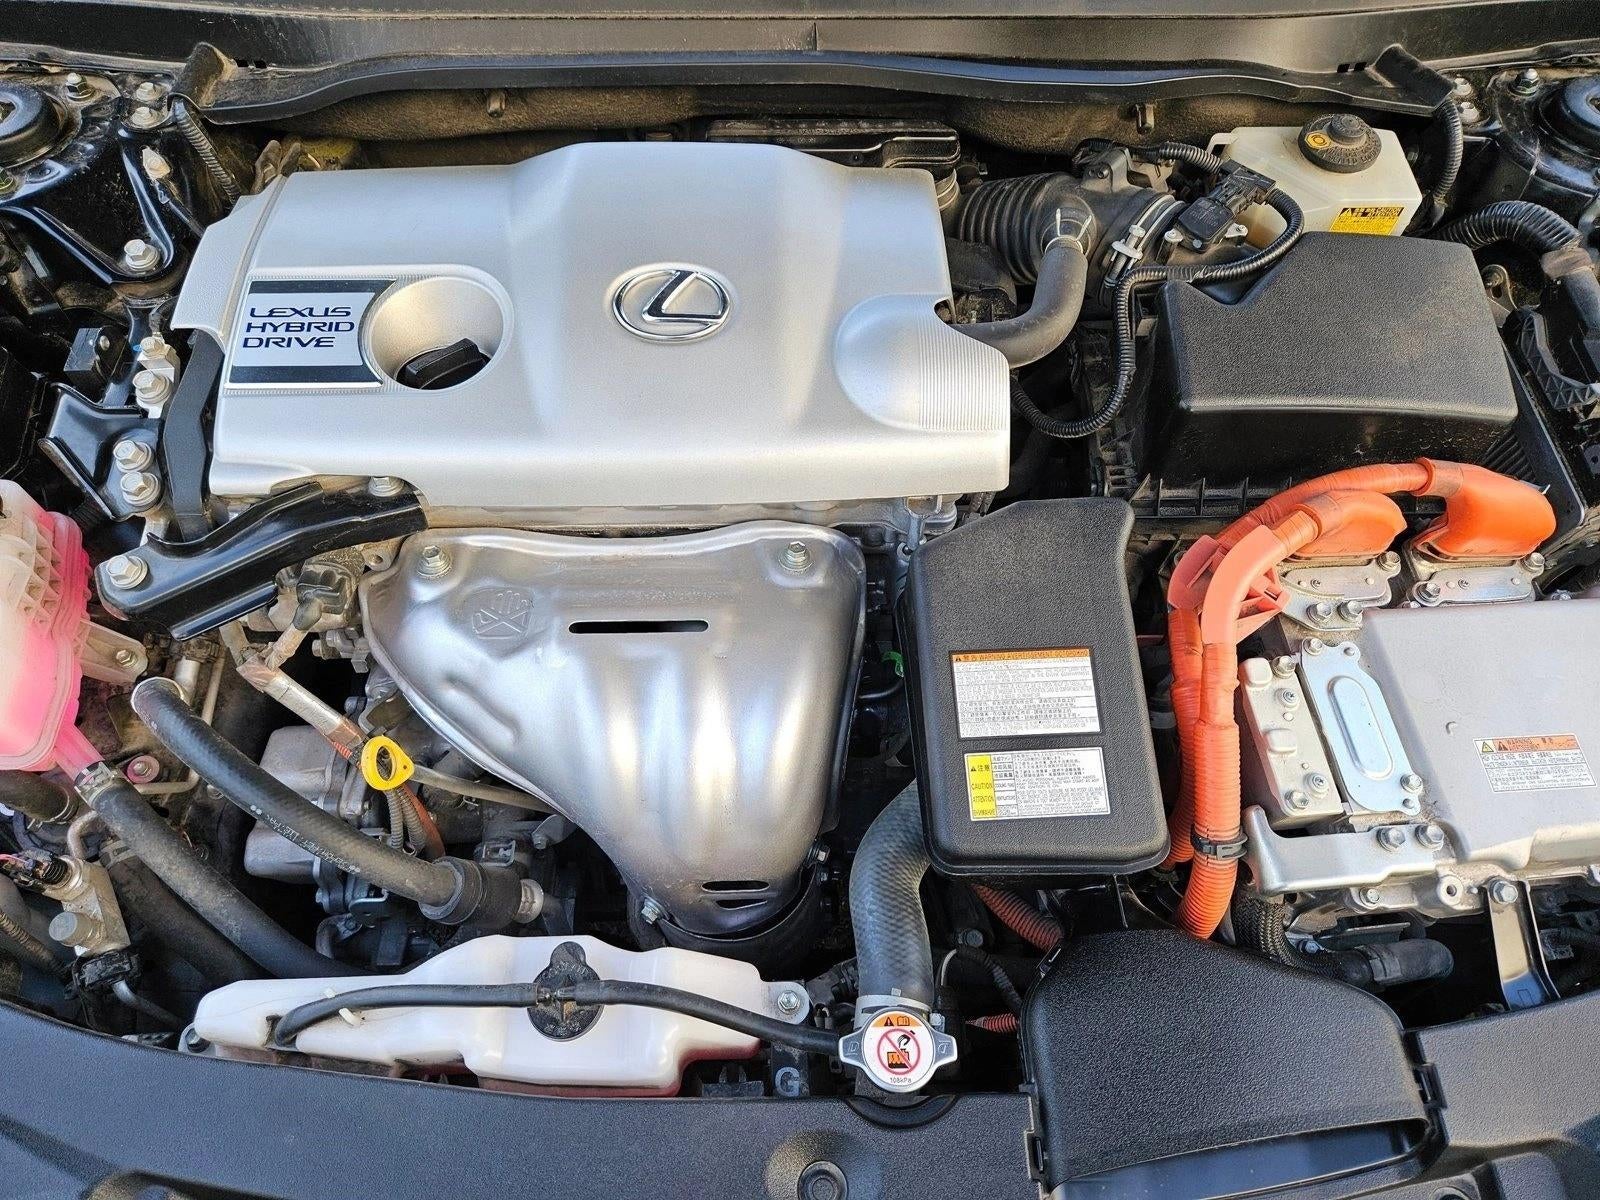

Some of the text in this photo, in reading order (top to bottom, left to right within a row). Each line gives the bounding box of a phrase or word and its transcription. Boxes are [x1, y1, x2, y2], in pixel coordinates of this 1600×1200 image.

[249, 306, 352, 318] LEXUS
[245, 321, 356, 333] HYBRID
[242, 336, 336, 348] DRIVE
[971, 782, 993, 791] CAUTION
[775, 1066, 800, 1097] G
[889, 1076, 912, 1084] 108kPa
